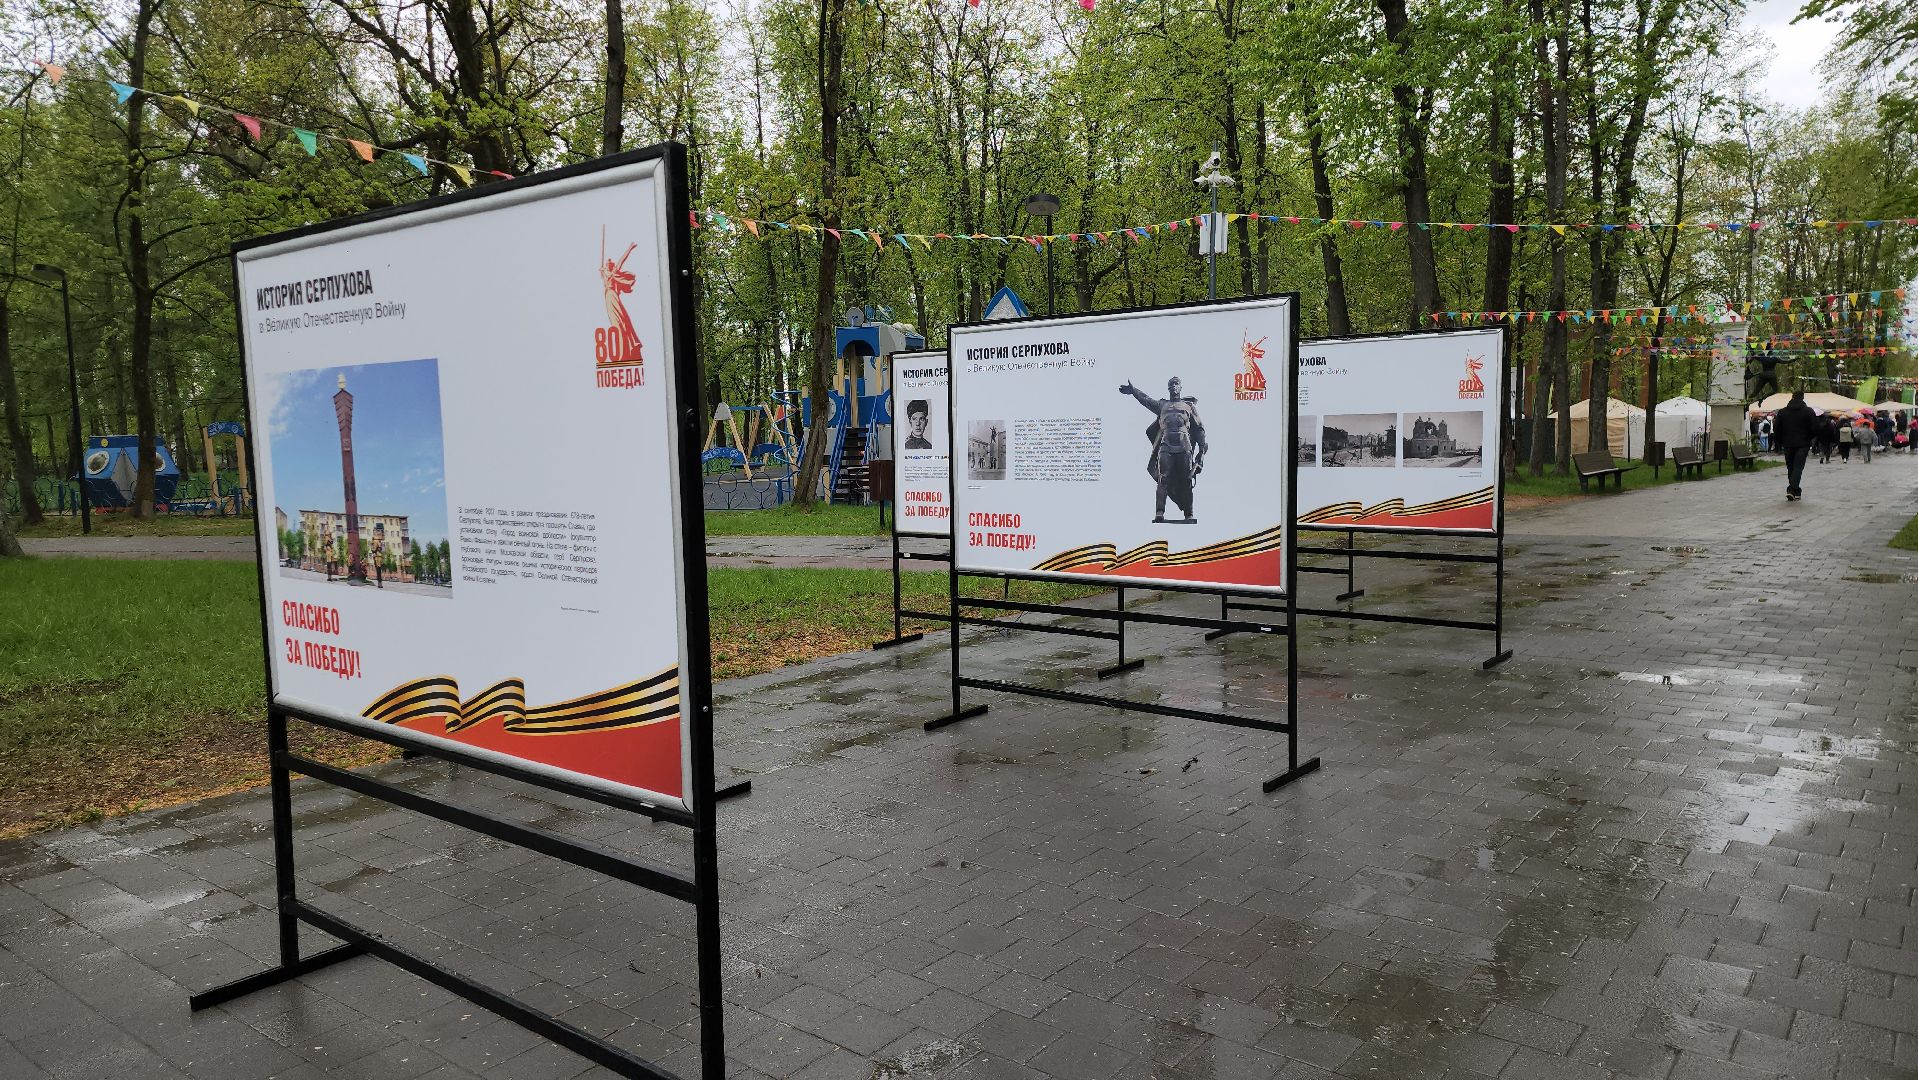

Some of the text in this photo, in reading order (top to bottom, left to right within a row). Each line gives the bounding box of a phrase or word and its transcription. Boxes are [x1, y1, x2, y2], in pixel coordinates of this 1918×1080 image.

[257, 269, 373, 311] ИСТОРИЯ СЕРПУХОВА
[259, 300, 407, 334] в Великую Отечественную Войну
[595, 326, 621, 364] 80
[967, 342, 1069, 361] ИСТОРИЯ СЕРПУХОВА
[903, 368, 933, 379] ИСТОРИЯ
[973, 363, 1006, 374] Великую
[1070, 357, 1096, 368] Войну
[596, 367, 645, 390] ПОБЕДА!
[1234, 372, 1251, 389] 80
[1459, 379, 1472, 391] 80
[1234, 391, 1267, 401] ПОБЕДА!
[904, 491, 942, 503] СПАСИБО
[905, 506, 916, 517] ЗА
[968, 512, 1021, 528] СПАСИБО
[969, 531, 1036, 551] ЗА ПОБЕДУ!
[282, 600, 340, 635] СПАСИБО
[285, 637, 362, 681] ЗА ПОБЕДУ!
